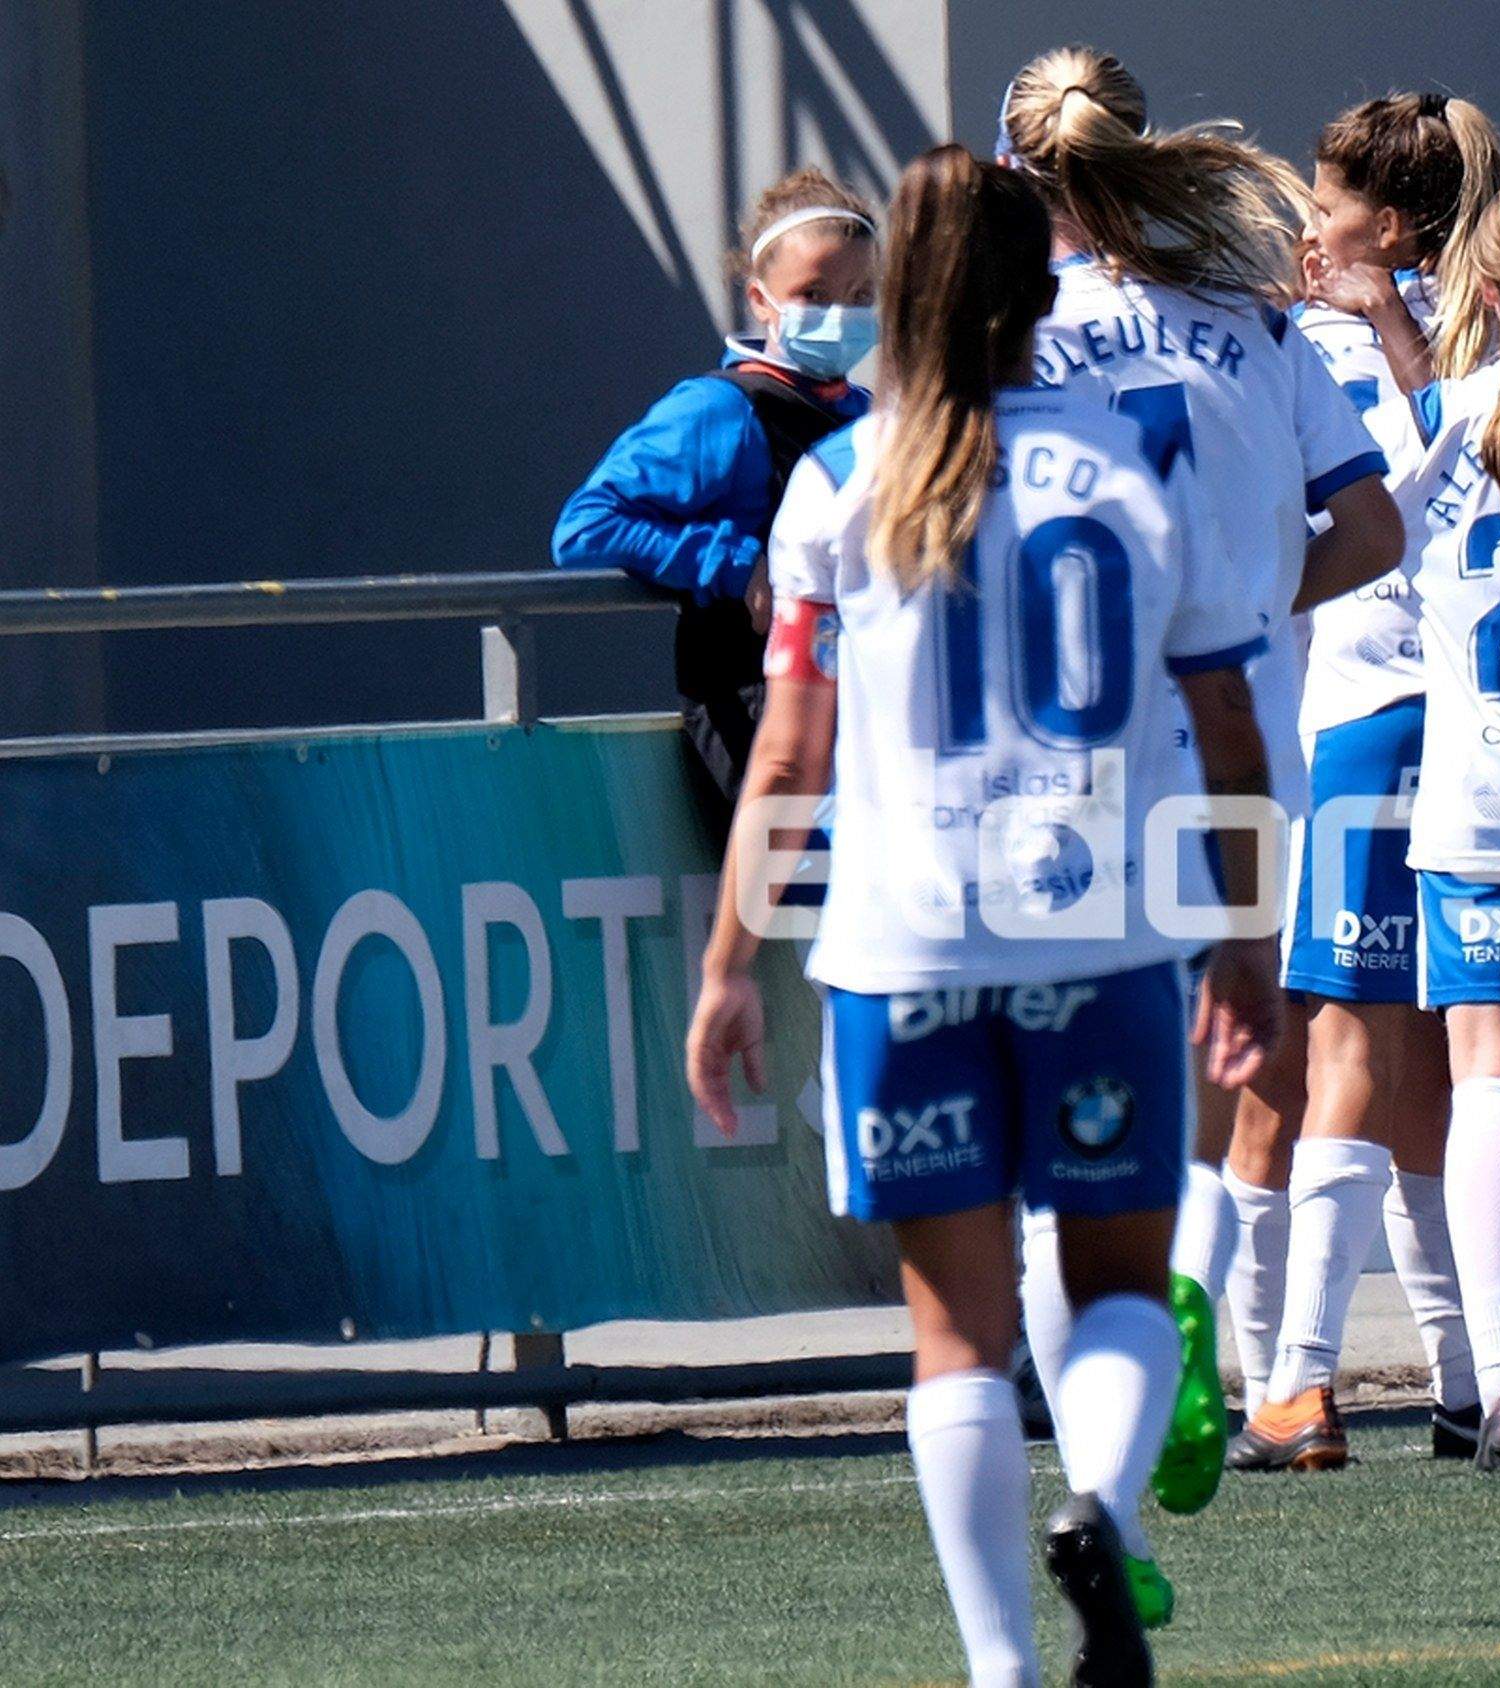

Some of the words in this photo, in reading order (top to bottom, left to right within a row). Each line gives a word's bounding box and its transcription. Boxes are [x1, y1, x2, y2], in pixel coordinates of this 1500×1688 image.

[930, 515, 1135, 754] 10
[1332, 947, 1410, 971] TENERIFE
[1333, 909, 1414, 950] DXT
[0, 876, 825, 1192] DEPORTE
[887, 984, 1099, 1044] Biner
[857, 1097, 975, 1160] DXT
[862, 1145, 984, 1182] TENERIFE
